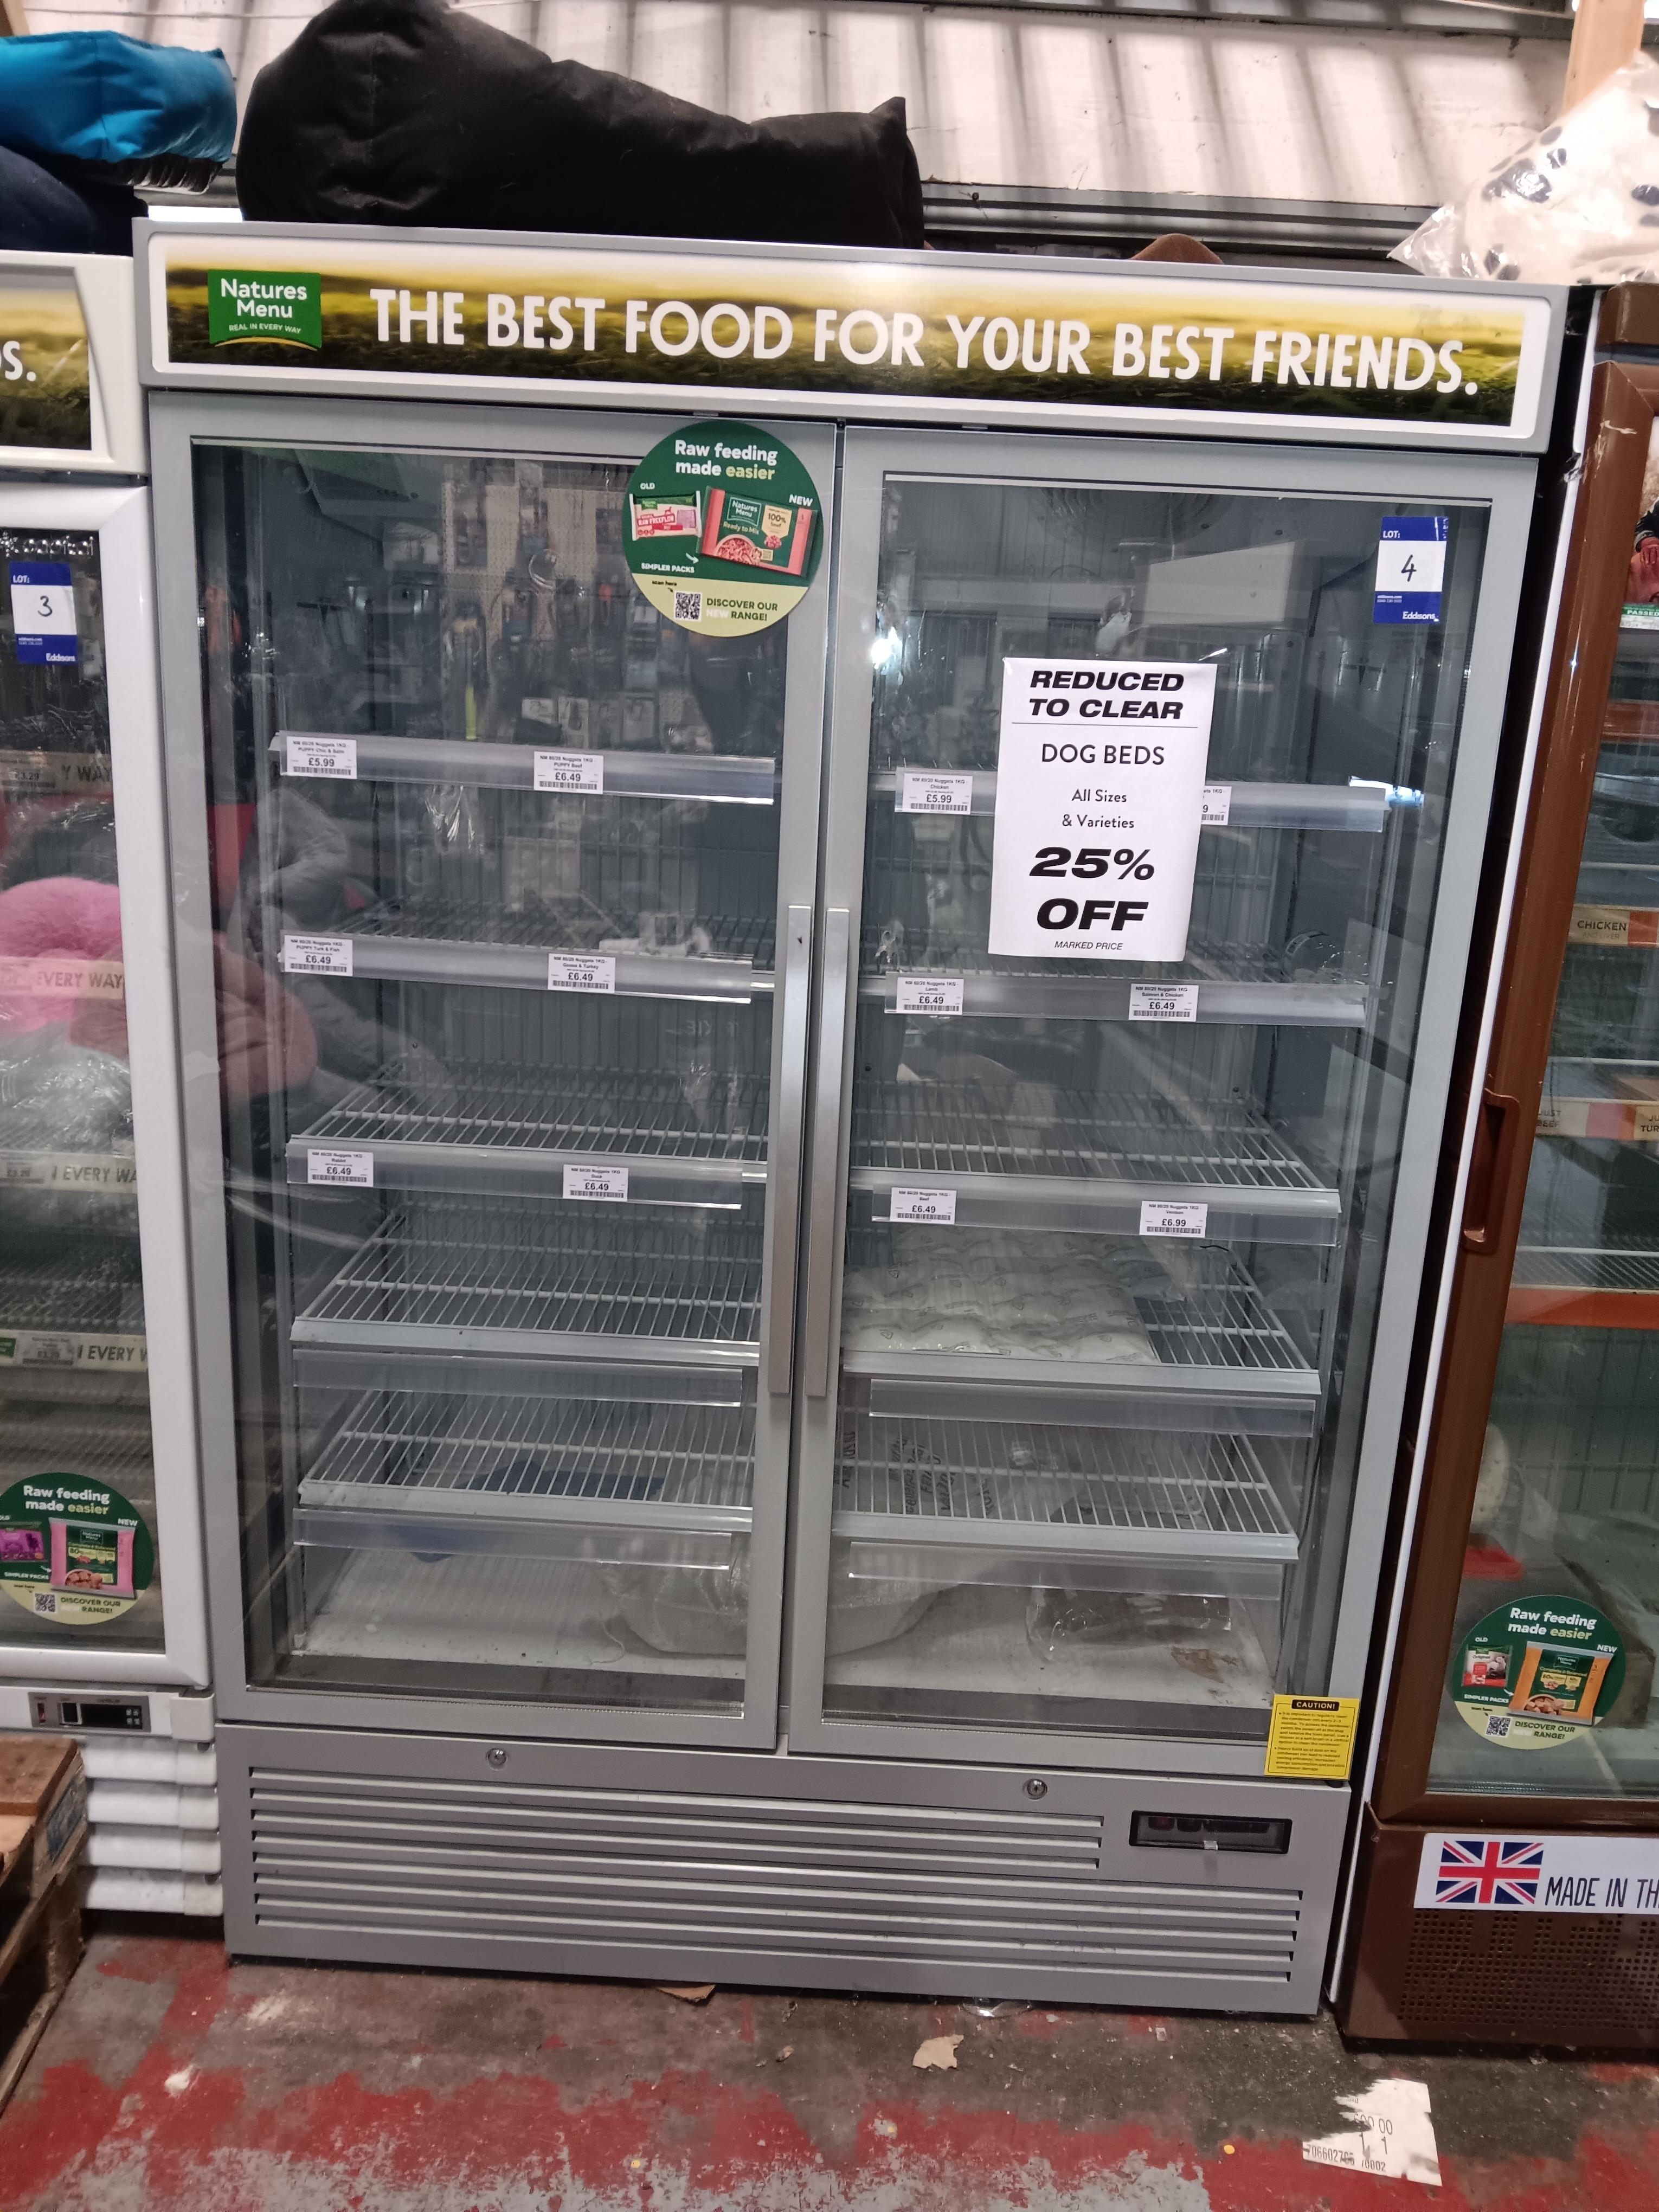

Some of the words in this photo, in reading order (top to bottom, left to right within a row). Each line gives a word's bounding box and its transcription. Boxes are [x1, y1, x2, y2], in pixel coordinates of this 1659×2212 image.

[221, 278, 307, 300] Natures
[237, 299, 292, 318] Menu
[369, 288, 465, 345] THE
[487, 293, 605, 352] BEST
[625, 300, 793, 359] FOOD
[814, 308, 924, 366] FOR
[945, 314, 1090, 375] YOUR
[1112, 323, 1234, 381] BEST
[1251, 330, 1478, 395] FRIENDS.
[675, 440, 709, 456] Raw
[715, 443, 778, 466] feeding
[676, 461, 722, 476] made
[725, 465, 775, 480] easier
[732, 500, 757, 512] Natures
[789, 494, 813, 506] NEW
[736, 509, 752, 517] Menu
[768, 513, 786, 523] 100%
[1383, 530, 1400, 538] LOT:
[641, 563, 670, 571] SIMPLER
[1401, 555, 1417, 582] 4
[12, 575, 30, 583] LOT:
[37, 595, 53, 617] 3
[706, 598, 755, 609] DISCOVER
[759, 602, 778, 611] OUR
[706, 609, 729, 618] NEW
[731, 612, 767, 621] RANGE!
[1030, 670, 1185, 692] REDUCED
[1029, 698, 1070, 716] TO
[1079, 699, 1184, 719] CLEAR
[1042, 744, 1096, 764] DOG
[1103, 745, 1165, 766] BEDS
[308, 757, 335, 767] £5.99
[555, 771, 581, 782] £6.49
[927, 794, 951, 803] £5.99
[1071, 788, 1090, 802] All
[1095, 789, 1127, 803] Sizes
[1062, 814, 1072, 827] &
[1077, 815, 1135, 829] Varieties
[1029, 846, 1155, 880] 25%
[1037, 898, 1149, 931] OFF
[1577, 920, 1626, 931] CHICKEN
[1054, 941, 1094, 950] MARKED
[1095, 942, 1123, 951] PRICE
[306, 955, 331, 964] £6.49
[89, 972, 124, 989] WAY
[568, 972, 593, 981] £6.49
[919, 996, 944, 1004] £6.49
[1149, 1002, 1175, 1010] £6.49
[63, 1166, 111, 1182] EVERY
[116, 1167, 137, 1183] WA
[326, 1166, 351, 1175] £6.49
[585, 1182, 609, 1191] £6.49
[912, 1205, 936, 1213] £6.49
[1162, 1218, 1186, 1227] £6.99
[87, 1345, 135, 1361] EVERY
[23, 1485, 53, 1497] Raw
[56, 1487, 110, 1504] feeding
[25, 1500, 64, 1512] made
[68, 1504, 108, 1515] easier
[118, 1518, 138, 1526] NEW
[60, 1597, 101, 1606] DISCOVER
[1510, 1607, 1541, 1621] Raw
[1544, 1611, 1597, 1630] feeding
[1508, 1623, 1547, 1635] made
[1549, 1628, 1592, 1640] easier
[1597, 1644, 1618, 1653] NEW
[1296, 1701, 1335, 1709] CAUTION!
[1515, 1721, 1556, 1731] DISCOVER
[1534, 1731, 1565, 1739] RANGE!
[1545, 1876, 1600, 1907] MADE
[1605, 1878, 1629, 1907] IN
[1636, 1879, 1659, 1909] TH
